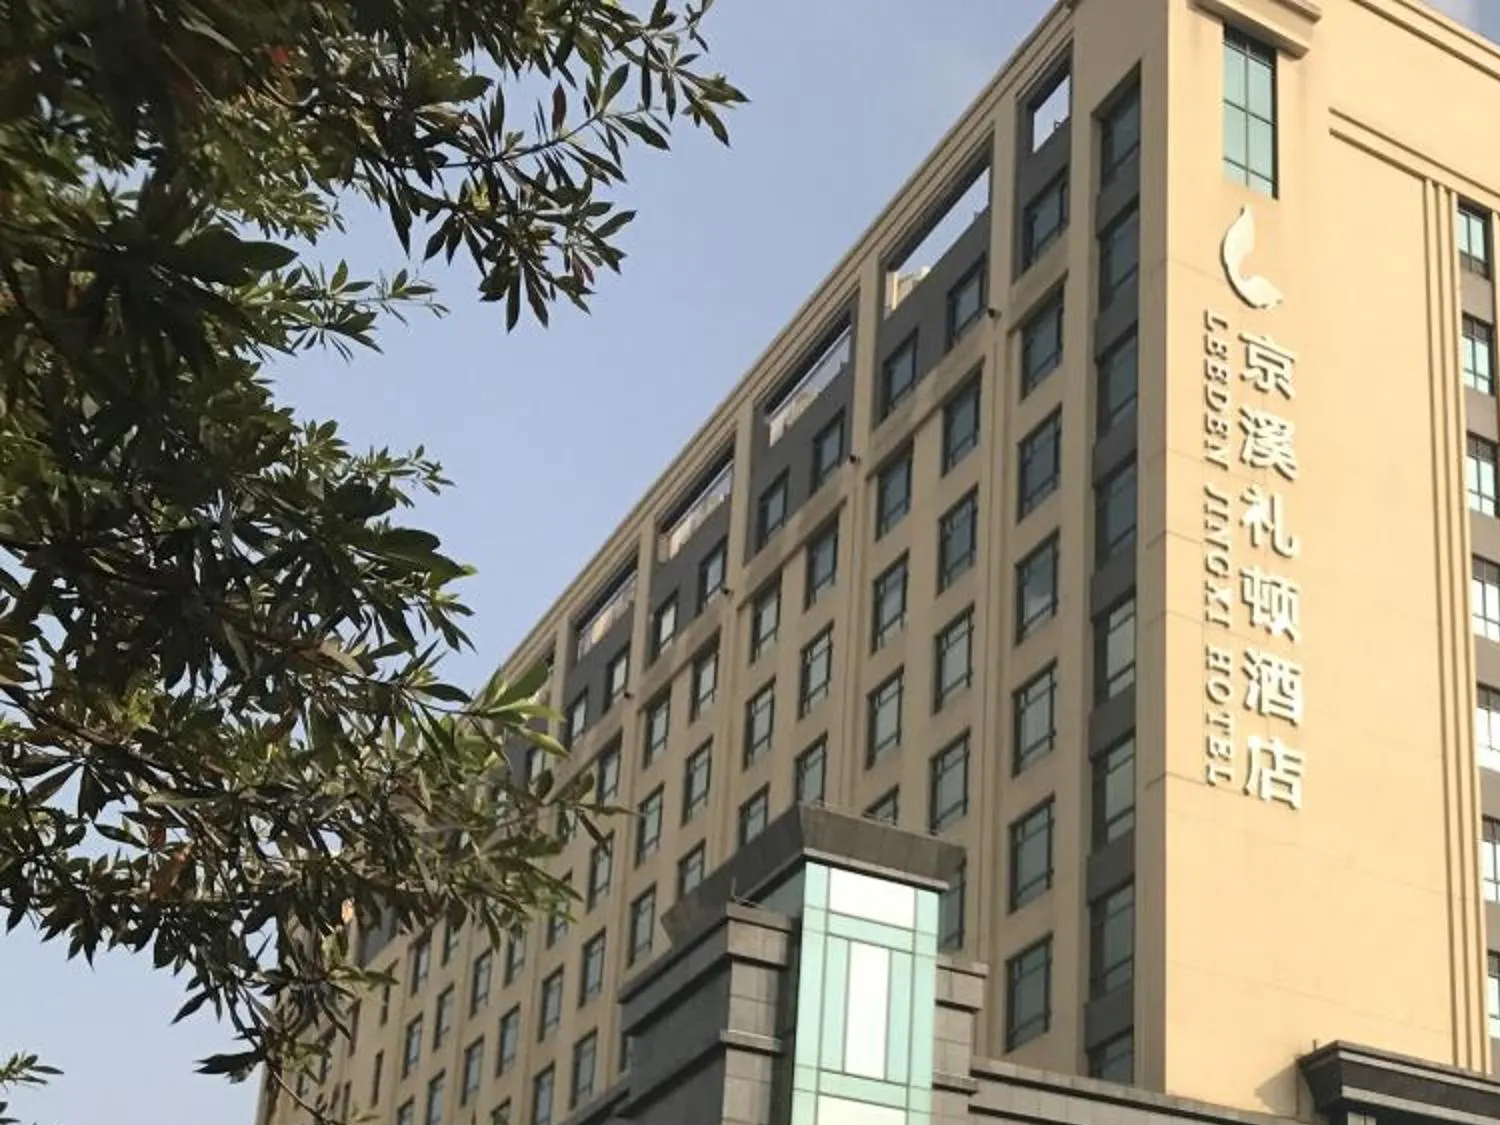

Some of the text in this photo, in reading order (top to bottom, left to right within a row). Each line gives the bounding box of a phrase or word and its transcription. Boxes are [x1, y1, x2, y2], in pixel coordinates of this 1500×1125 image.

[1203, 307, 1235, 788] LEEDEN JINGXI HOTEL
[1237, 328, 1305, 812] 京溪礼顿酒店
